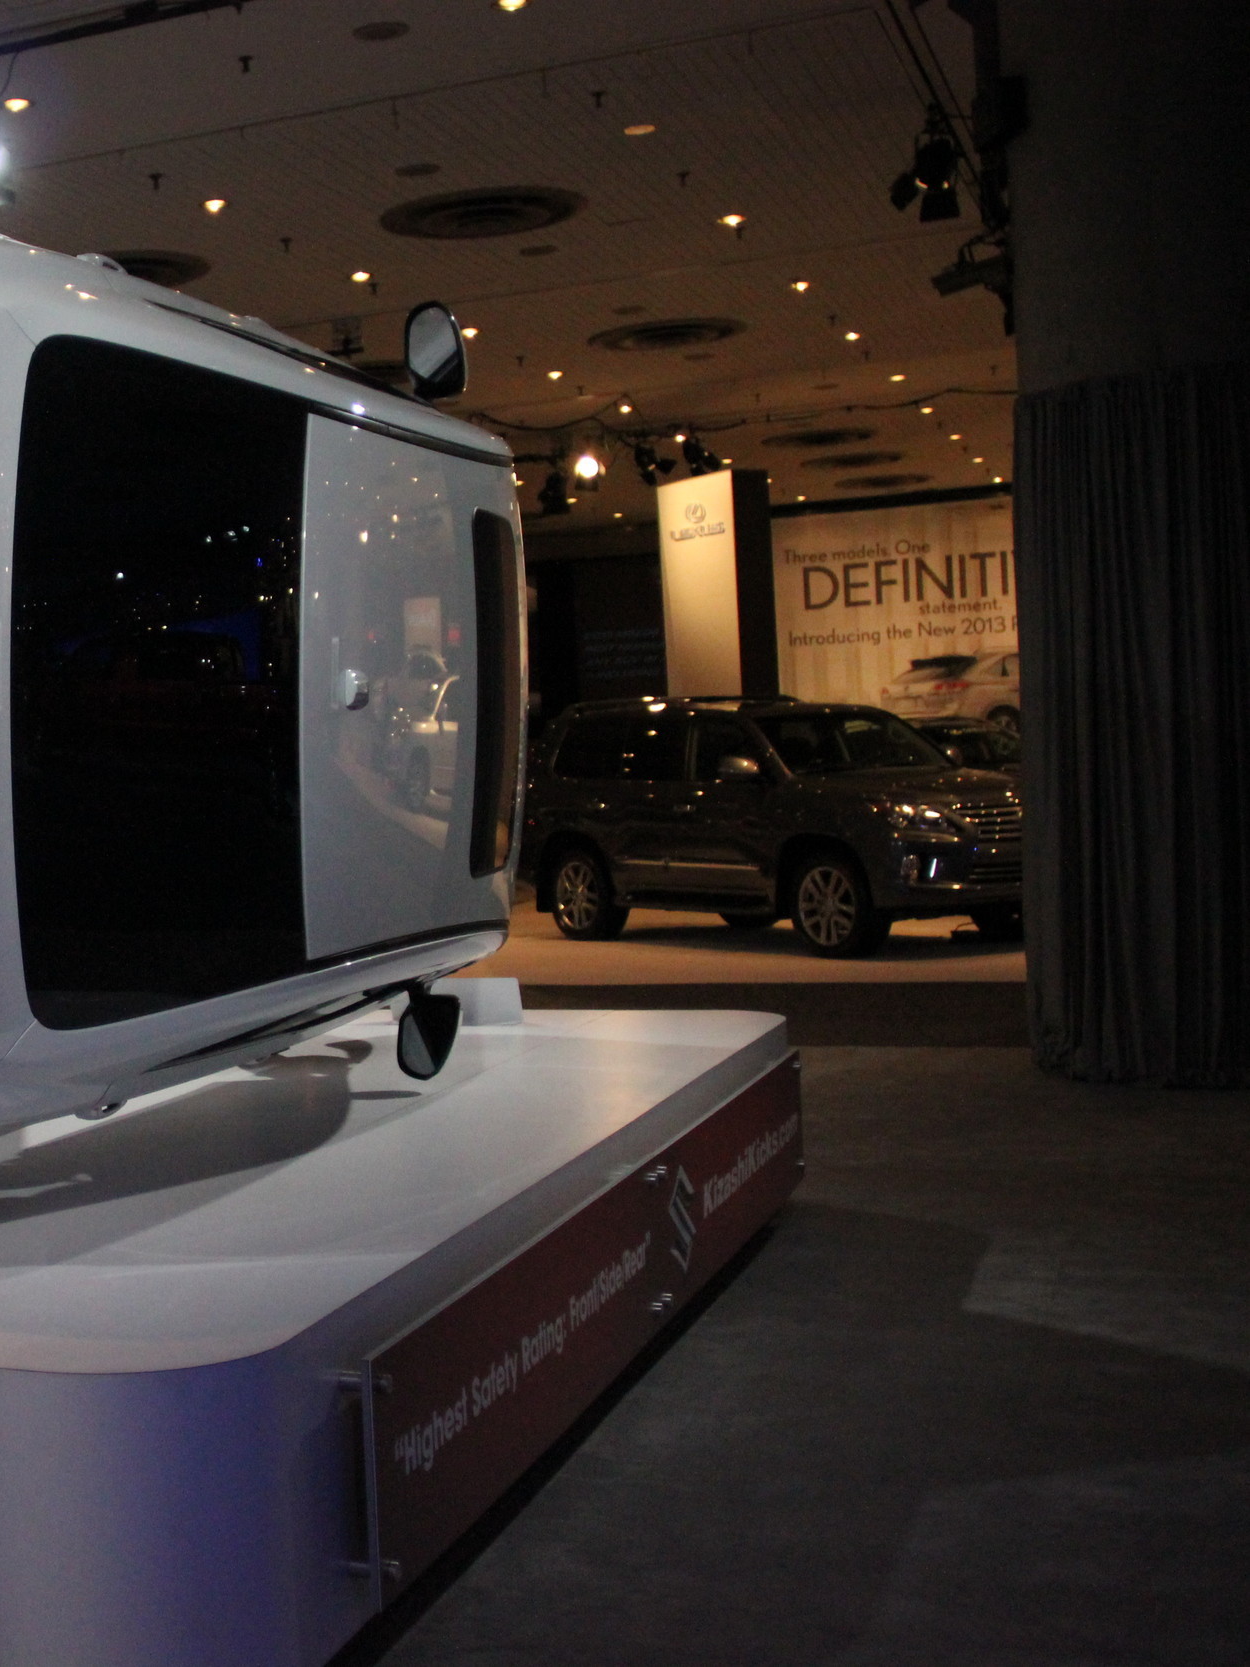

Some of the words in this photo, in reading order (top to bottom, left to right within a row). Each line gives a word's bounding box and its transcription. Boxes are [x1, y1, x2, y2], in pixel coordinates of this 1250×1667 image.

[784, 549, 827, 564] Three
[895, 539, 930, 555] One
[802, 551, 1016, 610] DEFINITI
[919, 600, 1002, 615] statement.
[789, 628, 881, 647] Introducing
[887, 625, 912, 640] the
[918, 622, 956, 637] New
[961, 616, 1006, 635] 2013
[471, 1352, 518, 1418] Safety
